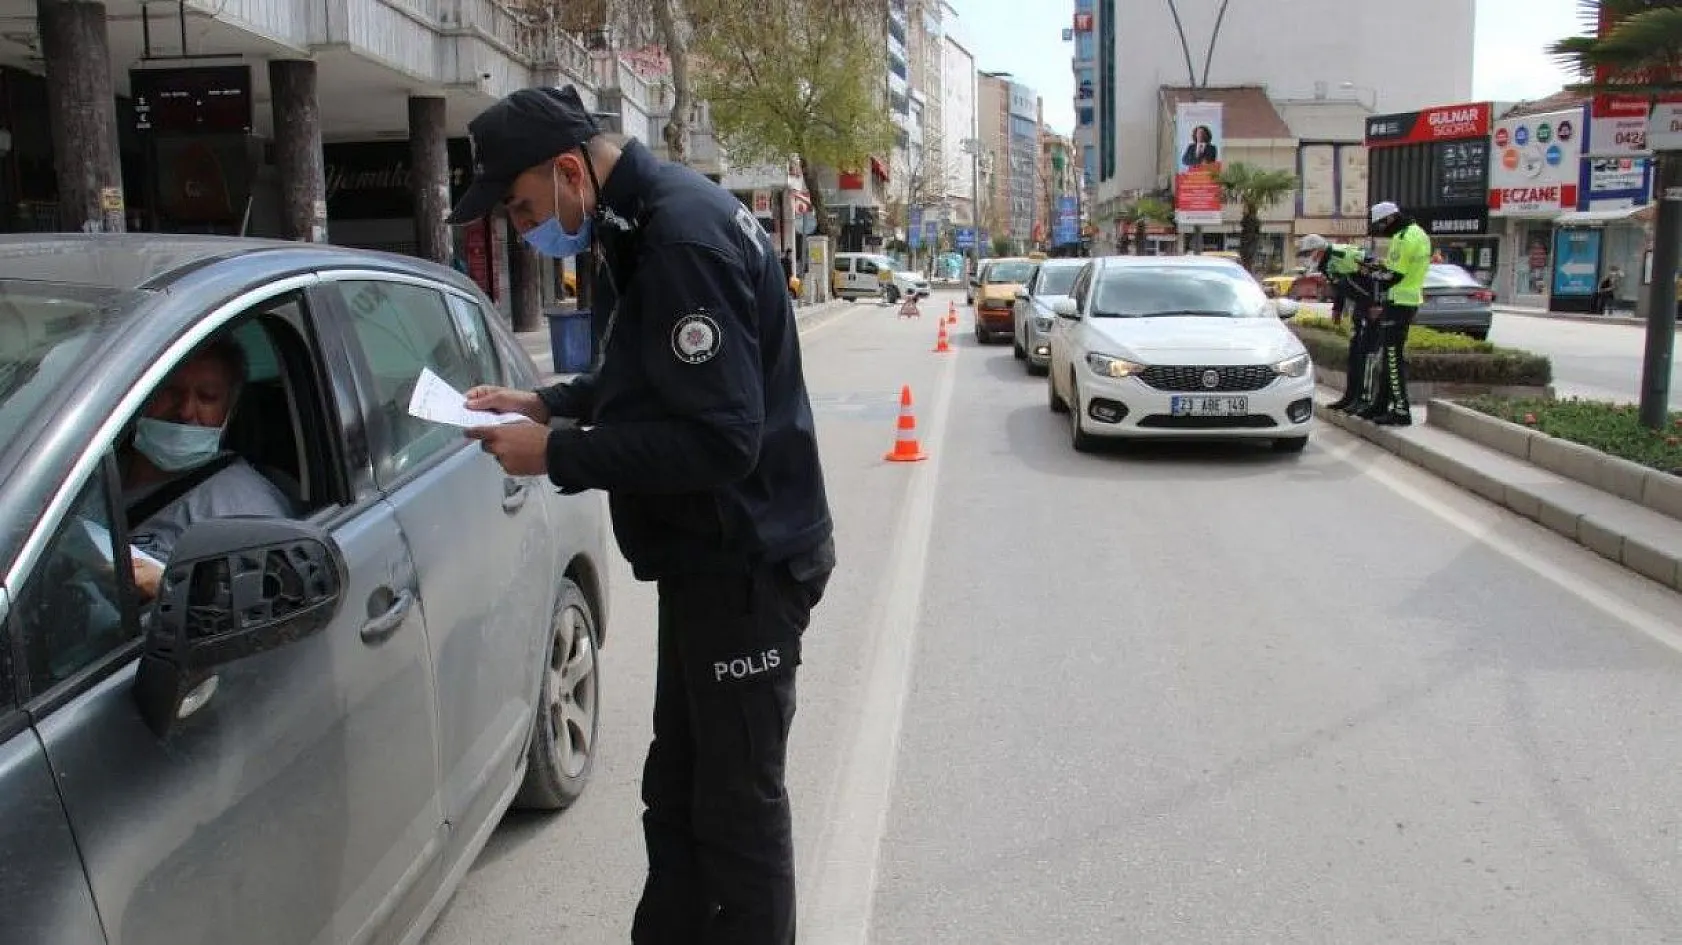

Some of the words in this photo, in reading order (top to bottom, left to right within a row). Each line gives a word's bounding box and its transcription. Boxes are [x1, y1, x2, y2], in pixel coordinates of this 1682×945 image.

[1502, 186, 1559, 204] ECZANE
[1431, 218, 1479, 233] SAMSUNG
[1227, 397, 1245, 410] 149
[713, 648, 781, 682] POLİS
